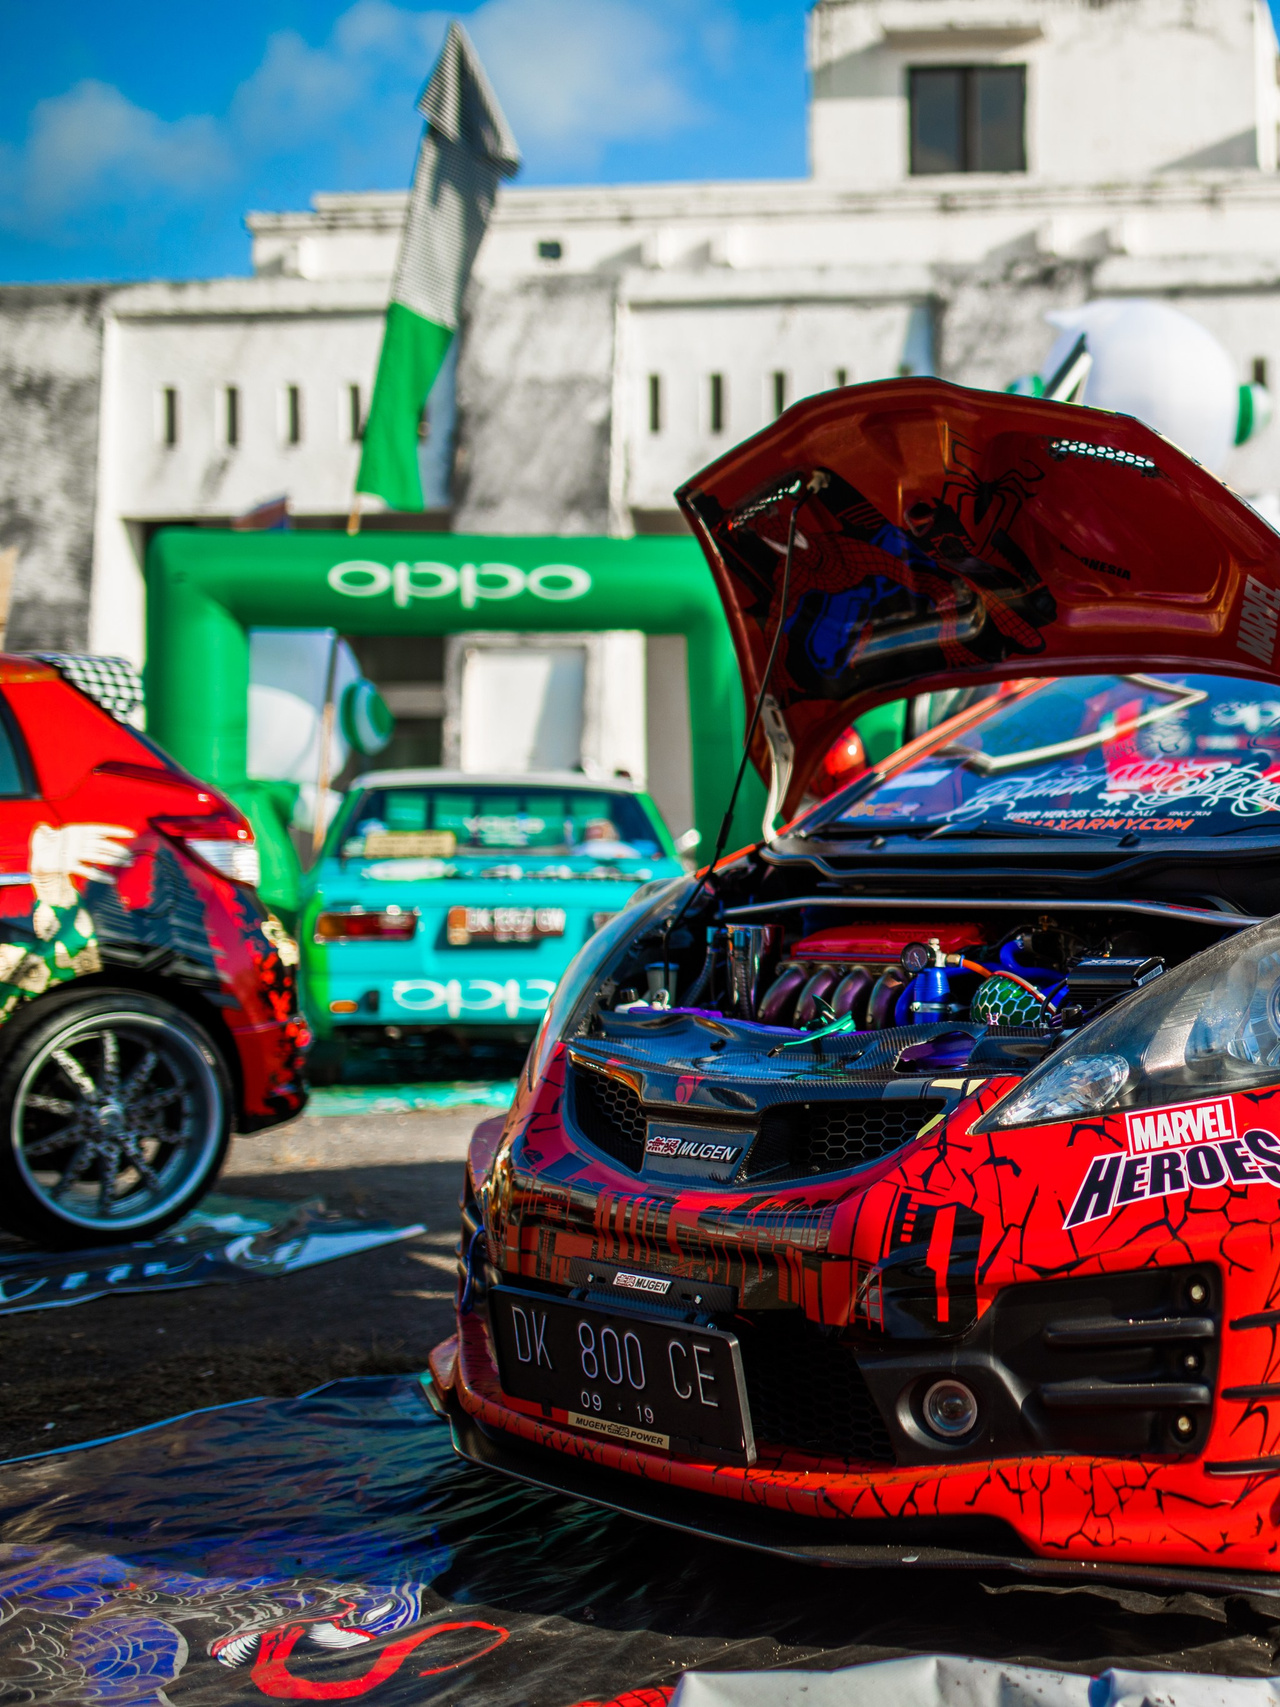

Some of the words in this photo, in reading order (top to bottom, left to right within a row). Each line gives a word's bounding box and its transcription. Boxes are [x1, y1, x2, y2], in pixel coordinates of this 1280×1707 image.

[328, 560, 592, 609] oppo
[1003, 810, 1041, 821] SUPER
[1040, 809, 1090, 819] HEROES
[393, 979, 556, 1019] opp
[1132, 1104, 1232, 1151] MARVEL
[678, 1142, 737, 1161] MUGEN
[635, 1278, 669, 1292] MUGEN
[511, 1305, 553, 1370] DK
[578, 1322, 646, 1390] 800
[668, 1341, 719, 1407] CE
[580, 1391, 602, 1411] 09
[636, 1405, 654, 1424] 19
[575, 1417, 607, 1431] MUGEN
[630, 1431, 664, 1445] POWER
